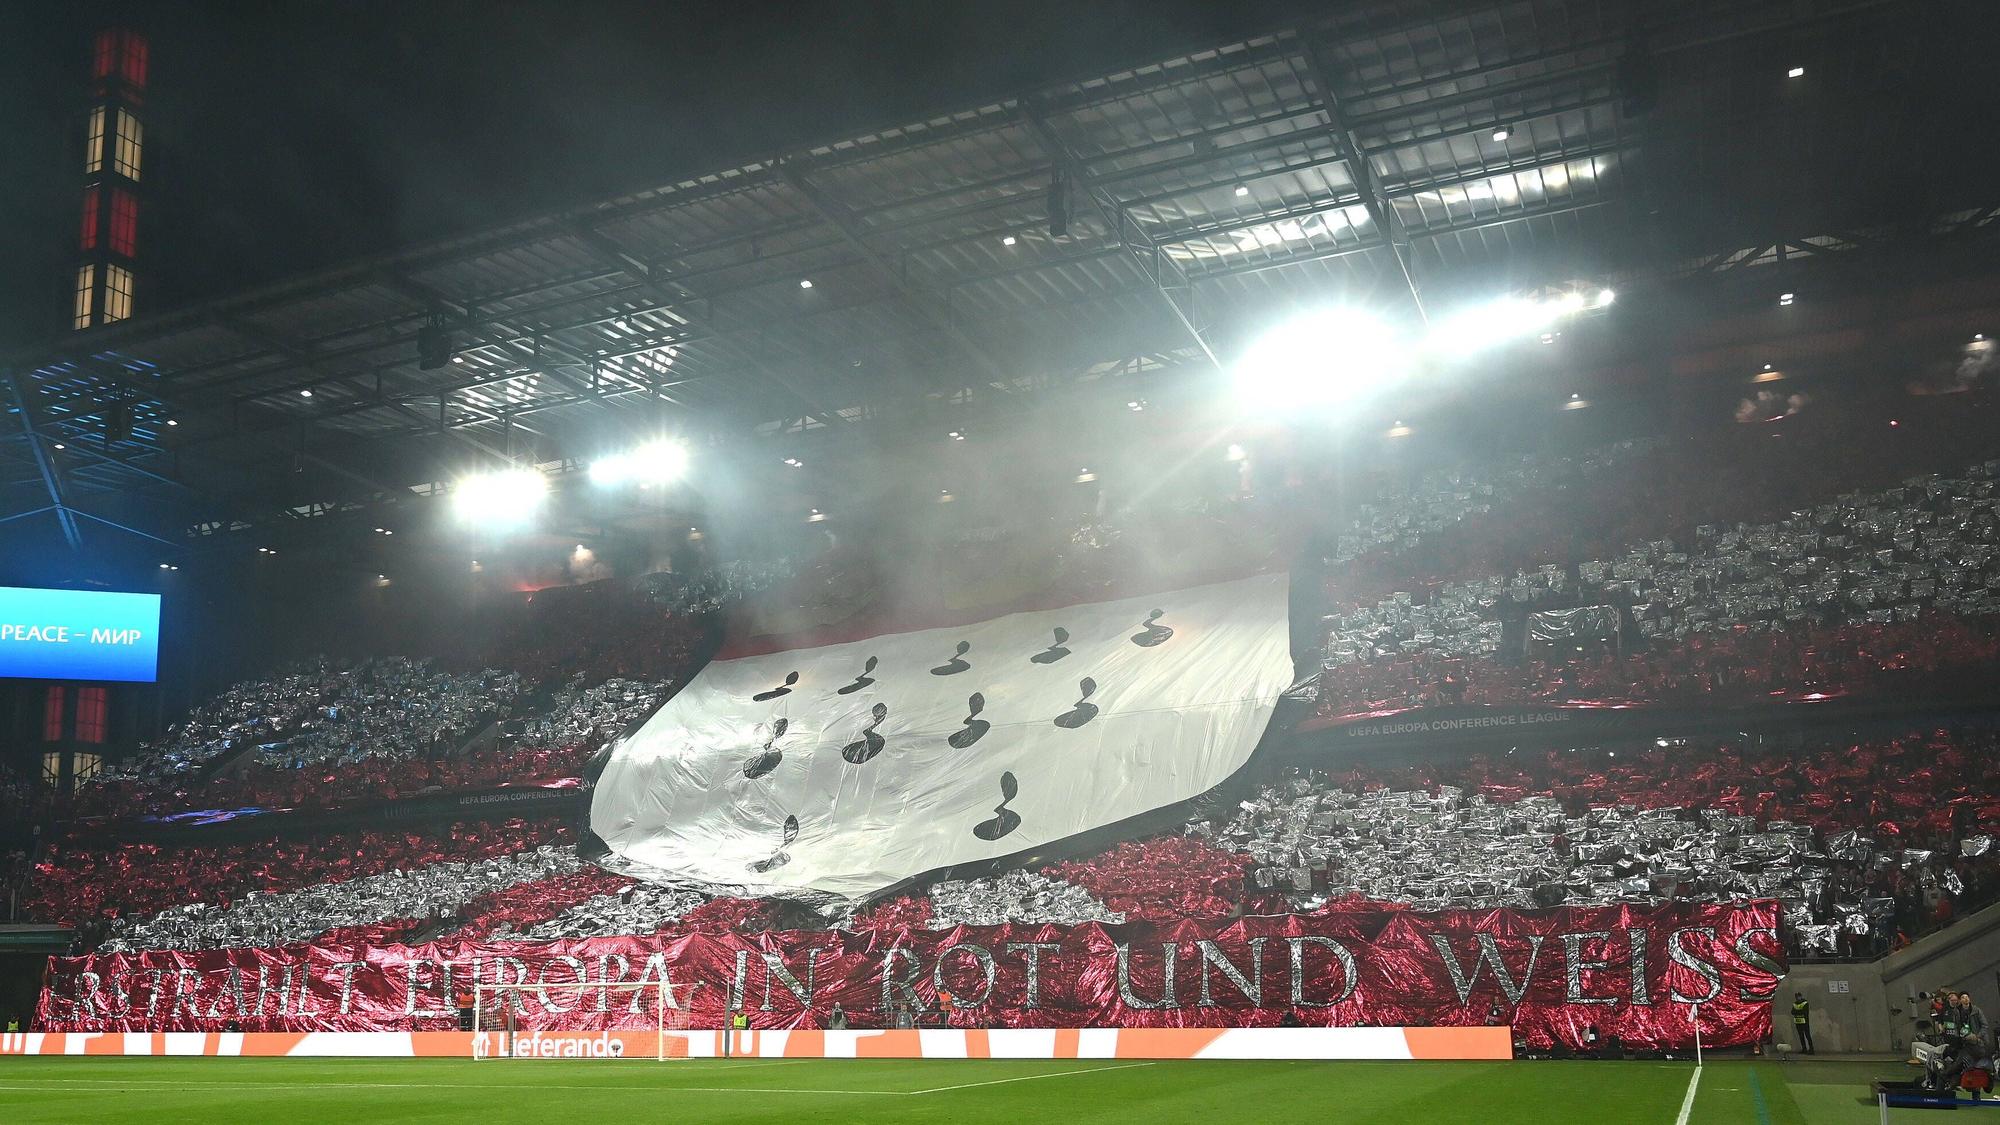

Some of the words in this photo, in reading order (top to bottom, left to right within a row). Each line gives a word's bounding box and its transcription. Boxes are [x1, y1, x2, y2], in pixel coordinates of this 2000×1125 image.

[1, 624, 69, 643] PEACE
[91, 627, 141, 645] МИР
[1348, 725, 1380, 737] UEFA
[1382, 722, 1430, 735] EUROPA
[1432, 715, 1516, 731] CONFERENCE
[1520, 711, 1570, 724] LEAGUE
[460, 796, 479, 804] UEFA
[480, 794, 509, 803] EUROPA
[510, 790, 562, 801] CONFERENCE
[46, 958, 366, 1021] ERSTRAHLT
[404, 951, 680, 1018] EUROPA
[733, 946, 822, 1013] IN
[880, 941, 1061, 1012] ROT
[1115, 935, 1360, 1009] UND
[1430, 926, 1789, 1007] WEISS
[498, 1032, 624, 1057] Lieferando
